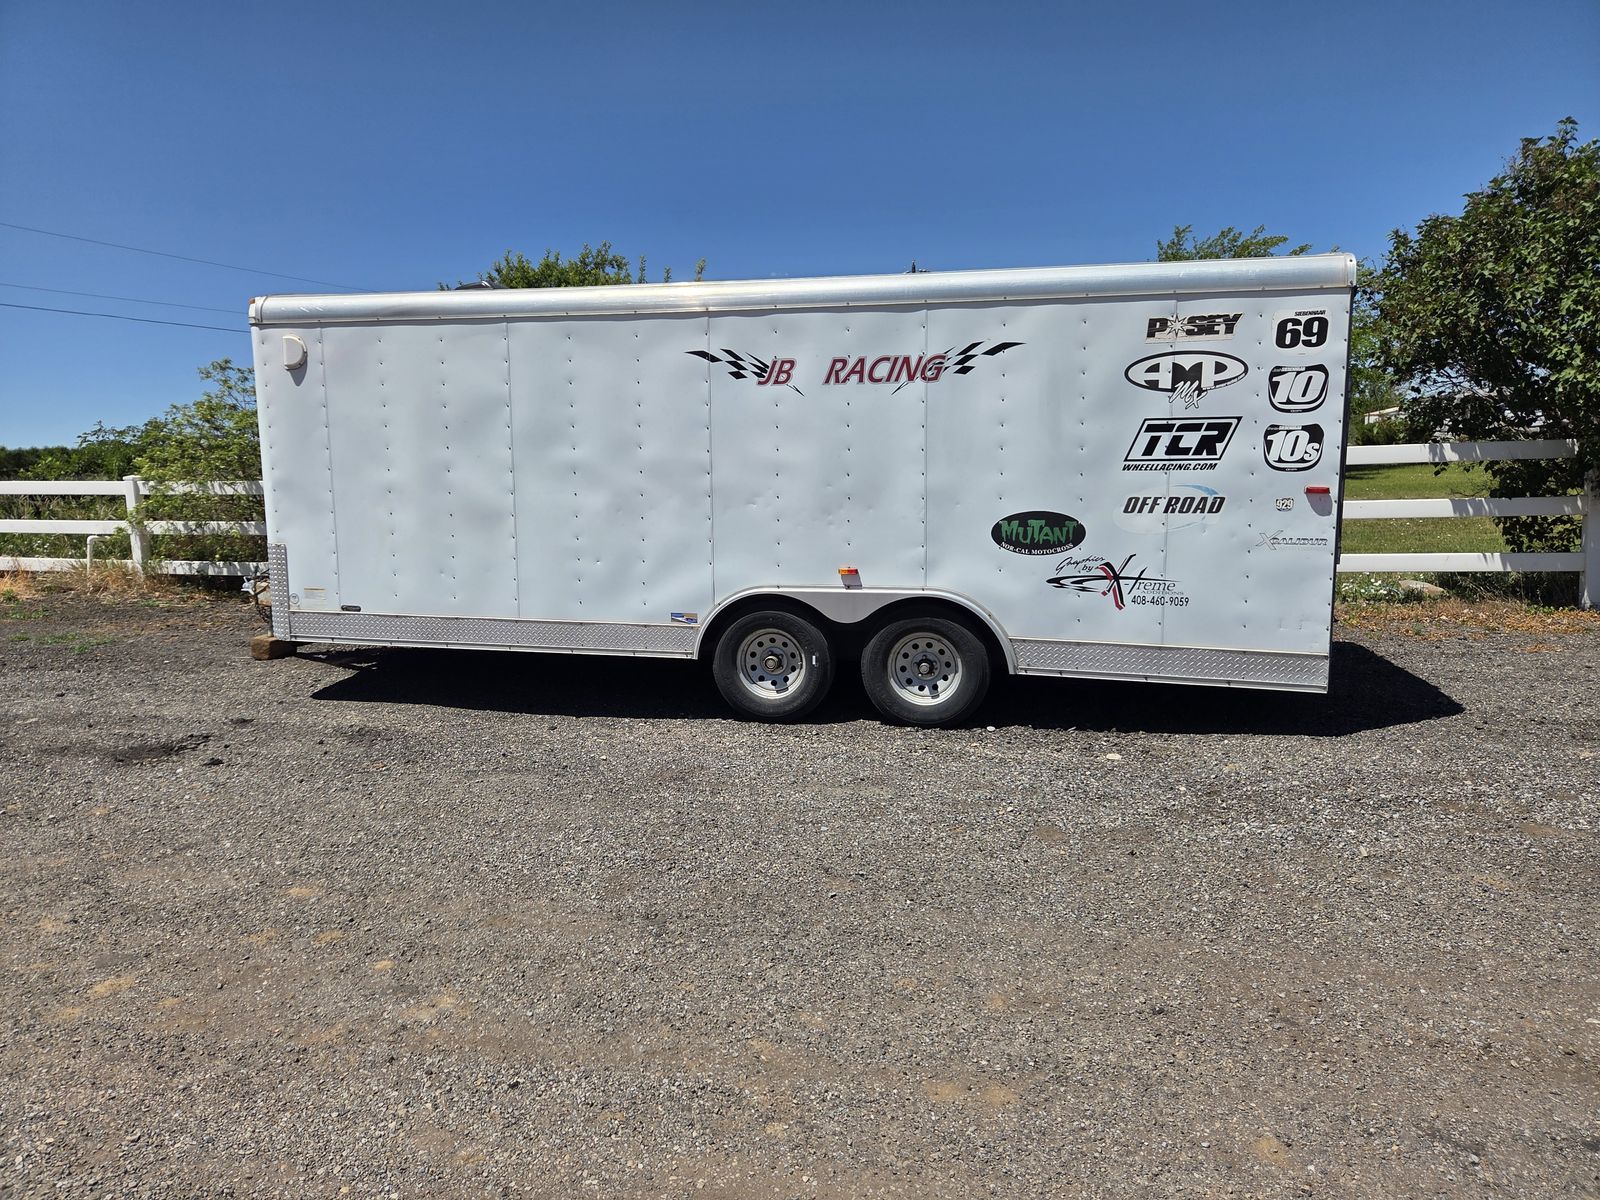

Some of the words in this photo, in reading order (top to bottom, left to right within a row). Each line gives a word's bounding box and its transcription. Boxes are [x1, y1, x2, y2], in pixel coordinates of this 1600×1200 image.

[1275, 316, 1329, 349] 69
[757, 357, 797, 386] JB
[821, 354, 950, 386] RACING
[1271, 370, 1326, 403] 10
[1141, 421, 1233, 456] TCR
[1121, 462, 1219, 472] WHEELLACING.COM
[1122, 496, 1163, 514] OFF
[1162, 496, 1226, 514] ROAD
[1276, 499, 1294, 509] 929
[999, 519, 1078, 545] MUTANT
[1000, 541, 1030, 555] NOR-CAL
[1031, 542, 1074, 555] MOTOCROSS
[1055, 555, 1105, 575] Graphics
[1081, 564, 1094, 572] by
[1131, 595, 1190, 607] 408-460-9059
